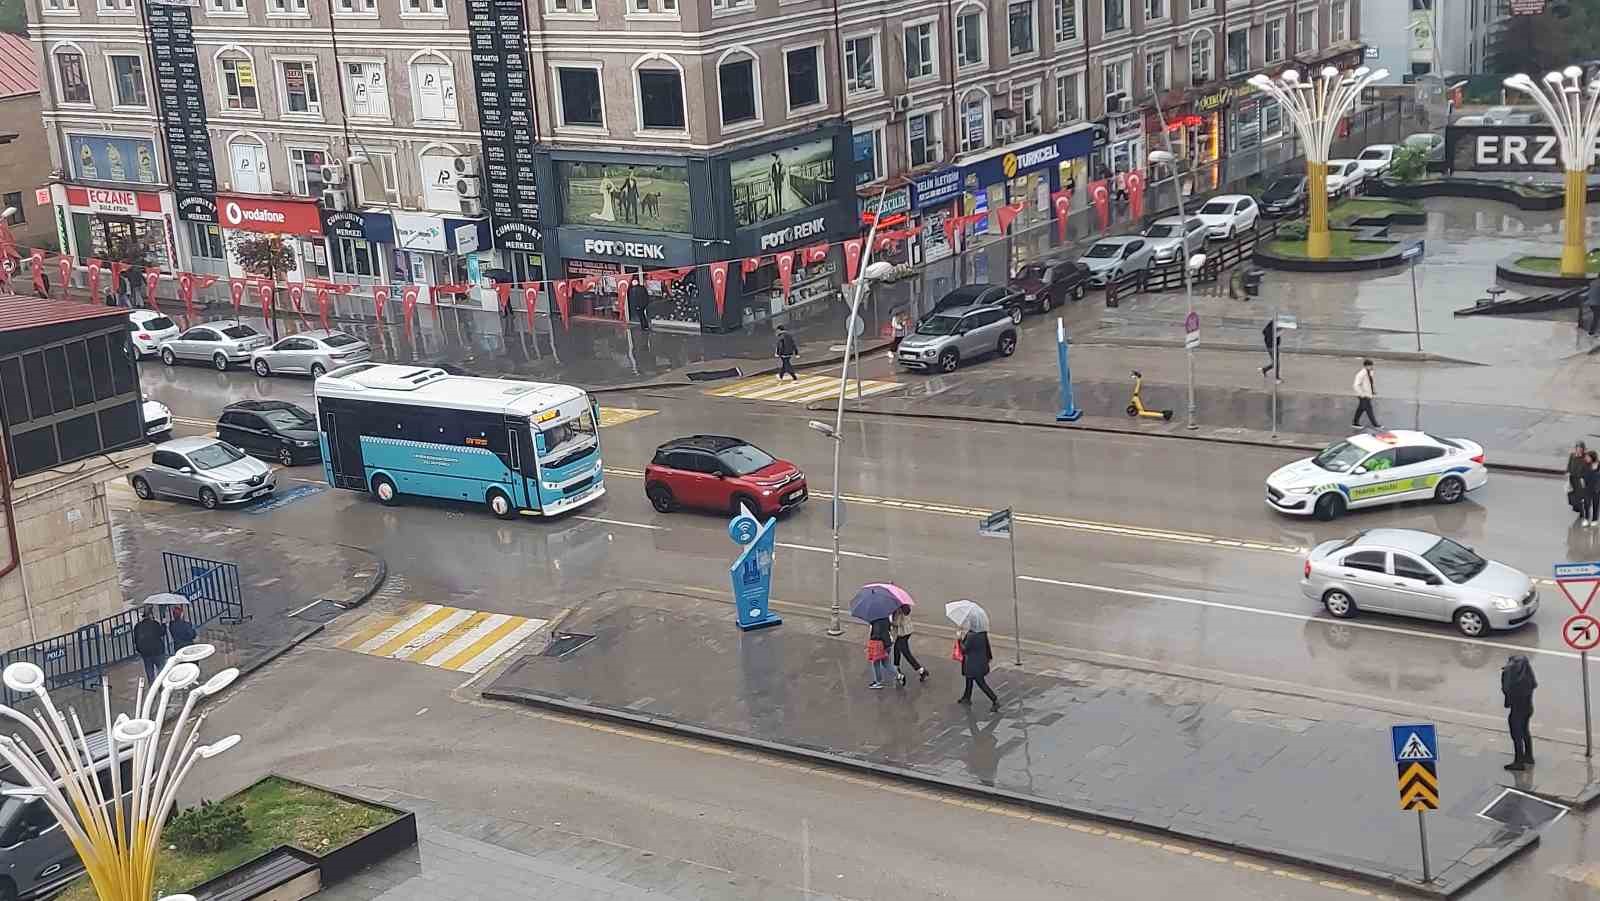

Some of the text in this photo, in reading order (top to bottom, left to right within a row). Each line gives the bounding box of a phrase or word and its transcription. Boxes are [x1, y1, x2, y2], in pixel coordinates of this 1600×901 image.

[1016, 144, 1060, 169] TURKCELL
[89, 190, 134, 206] ECZANE
[241, 209, 285, 223] vodafone
[760, 217, 826, 250] FOTORENK
[584, 239, 665, 259] FOTORENK
